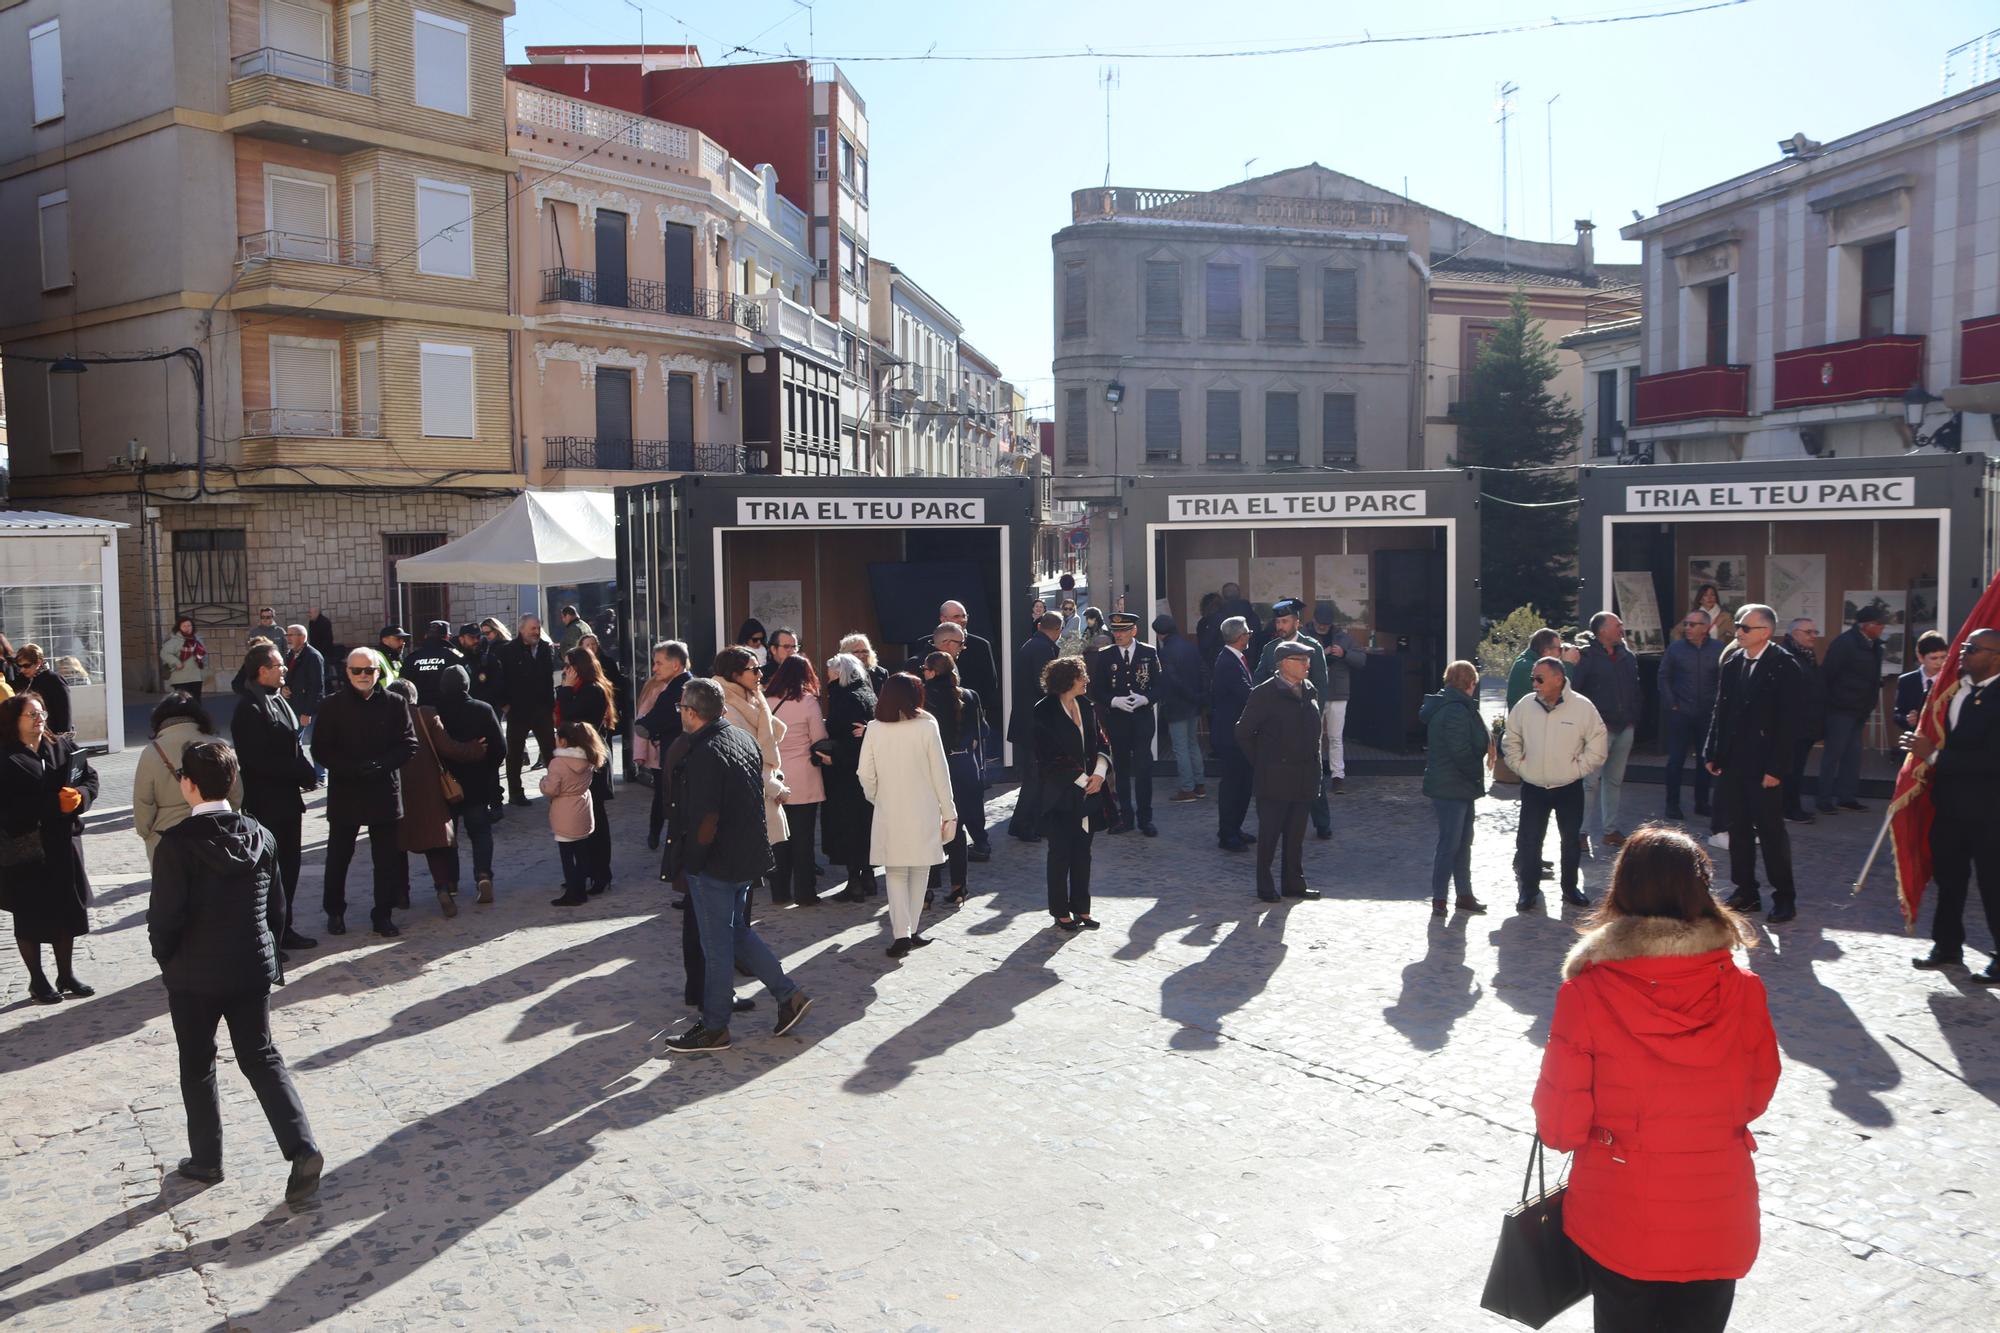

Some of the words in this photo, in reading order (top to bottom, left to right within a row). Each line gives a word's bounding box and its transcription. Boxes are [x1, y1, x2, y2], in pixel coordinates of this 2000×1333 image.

[1176, 498, 1239, 516] TRIA
[1247, 497, 1278, 515] EL
[1283, 495, 1336, 513] TEU
[1345, 493, 1417, 513] PARC
[1635, 488, 1701, 508] TRIA
[1710, 487, 1743, 506] EL
[1750, 485, 1809, 505] TEU
[1818, 482, 1903, 503] PARC
[745, 501, 810, 521] TRIA
[817, 502, 848, 520] EL
[852, 502, 903, 520] TEU
[911, 501, 976, 520] PARC
